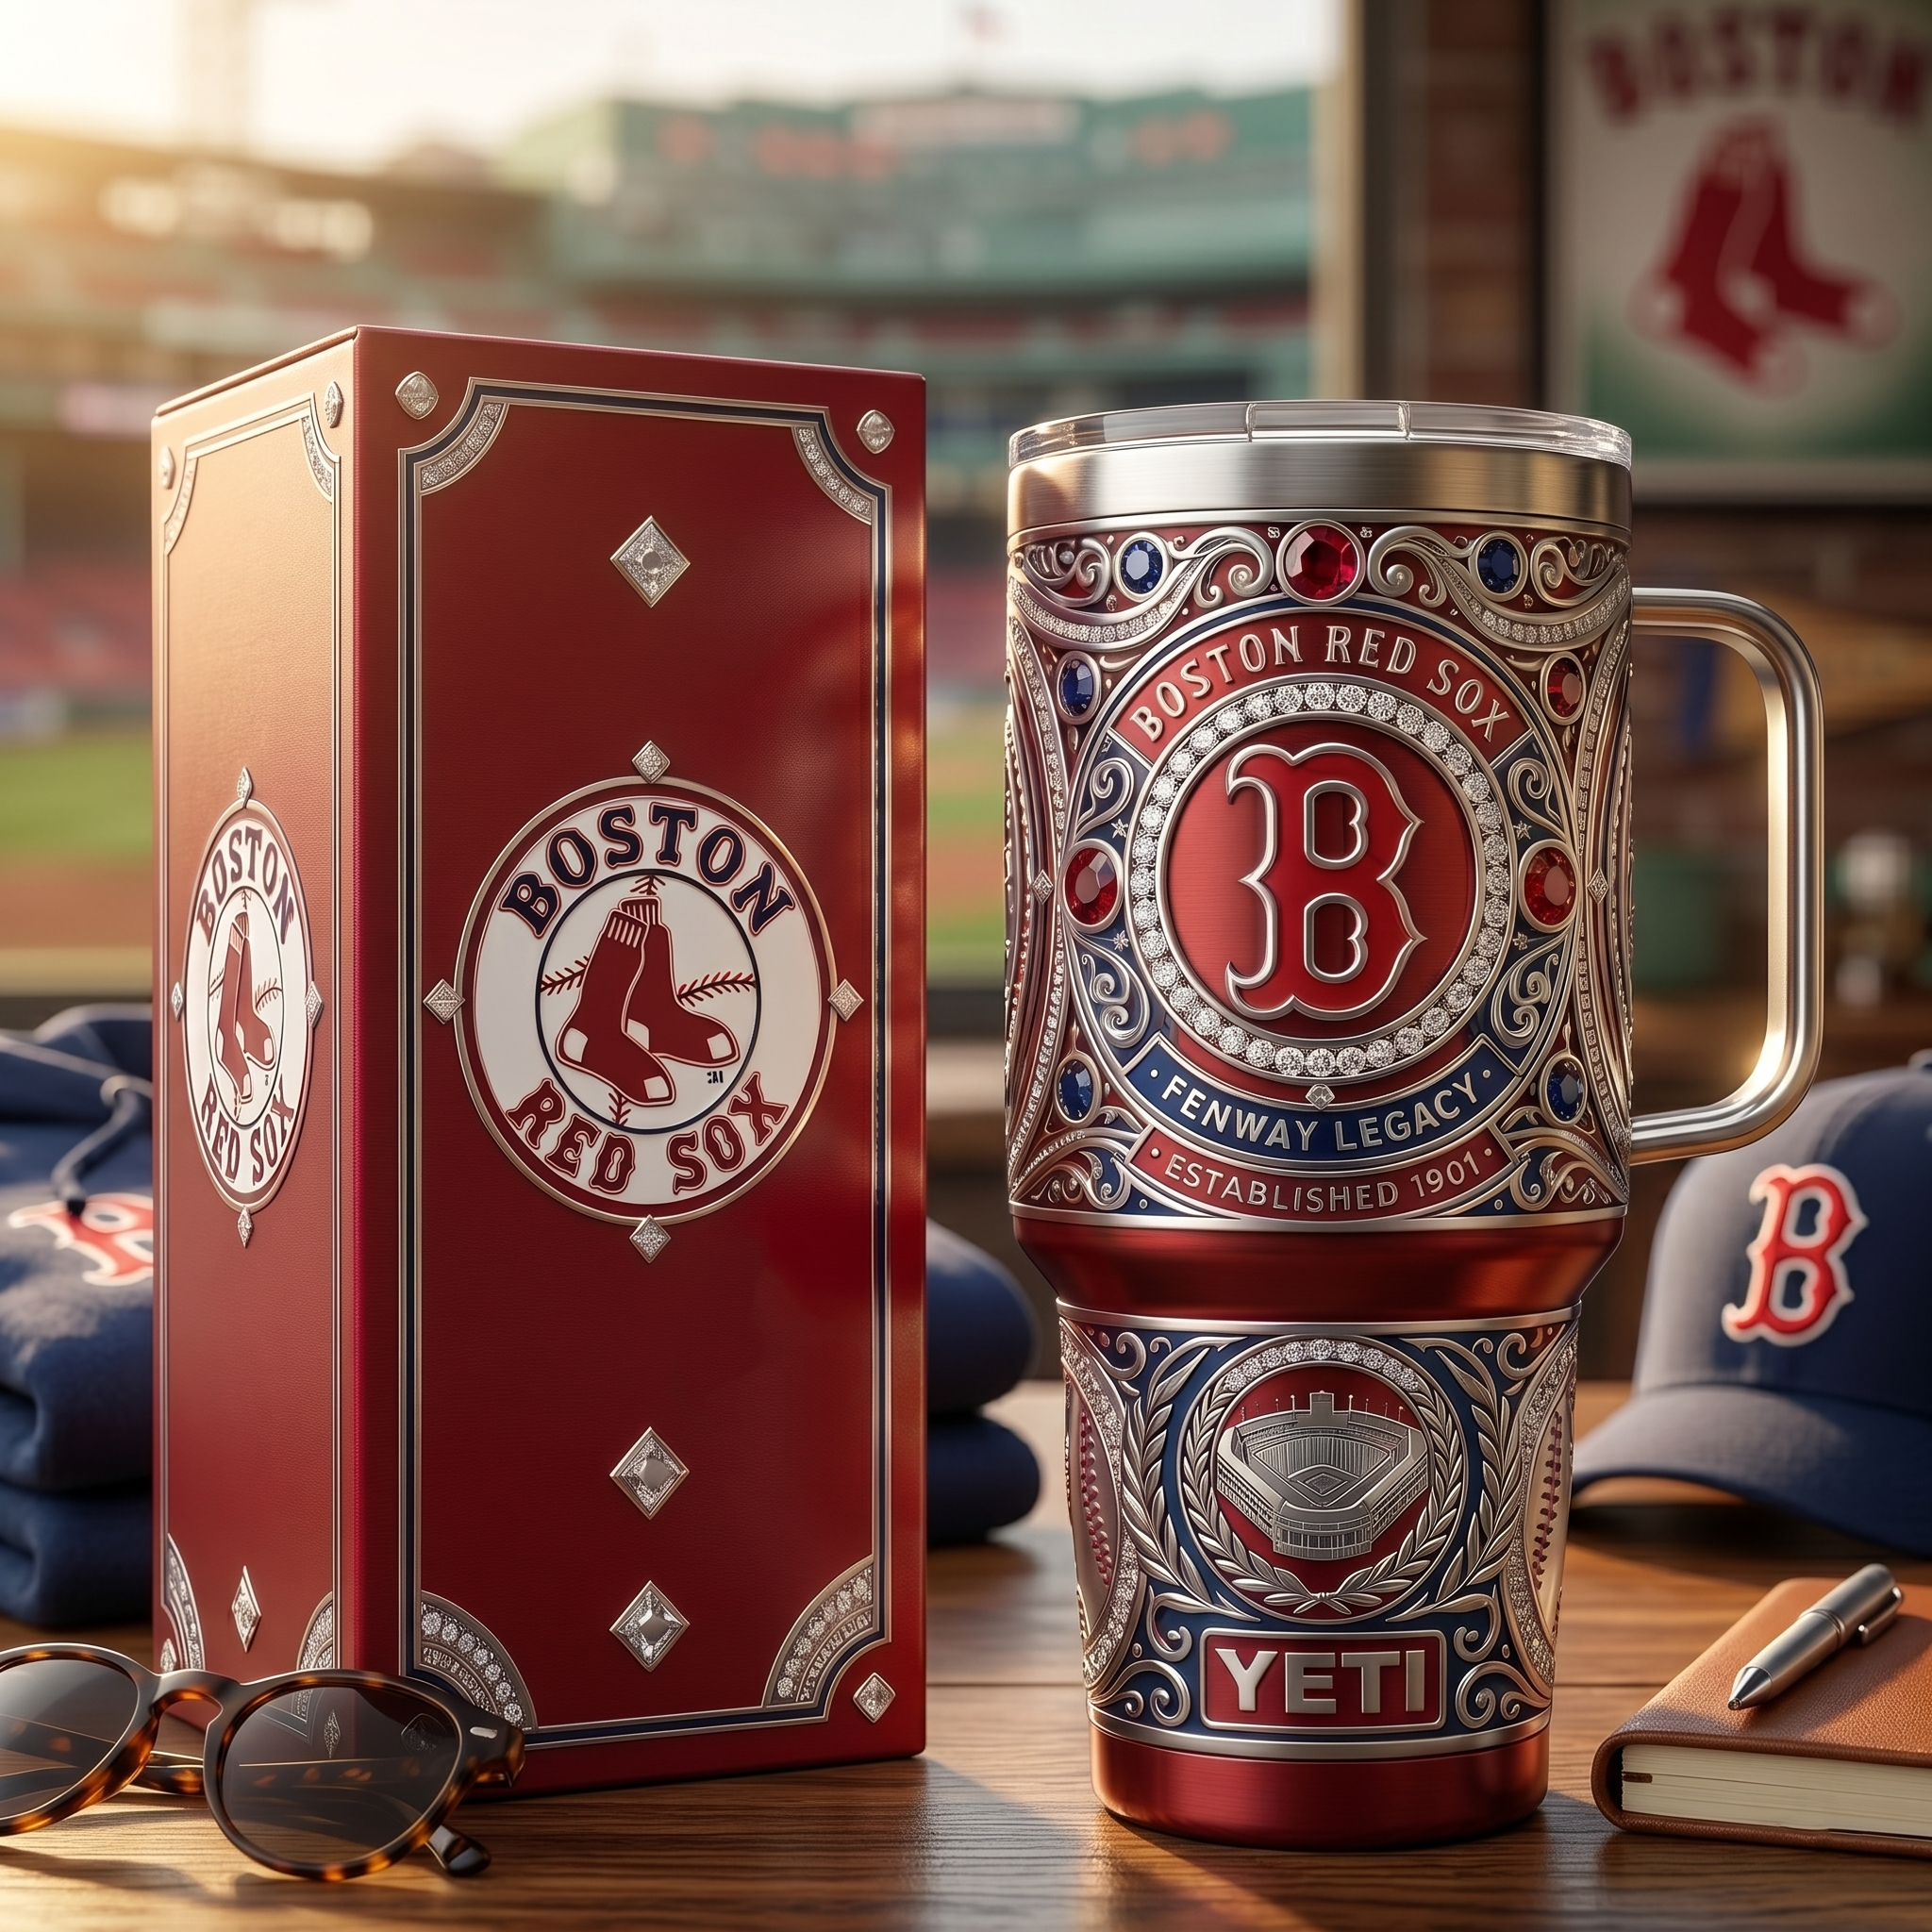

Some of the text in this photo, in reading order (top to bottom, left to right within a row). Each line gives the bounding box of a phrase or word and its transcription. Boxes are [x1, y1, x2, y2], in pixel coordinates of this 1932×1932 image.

[1129, 625, 1509, 741] BOSTON RED SOX
[196, 825, 294, 945] BOSTON
[499, 802, 794, 940] BOSTON
[1225, 742, 1427, 1021] B
[201, 1073, 294, 1187] RED SOX
[506, 1071, 790, 1195] RED SOX
[1161, 1072, 1480, 1152] FENWAY LEGACY
[1163, 1149, 1481, 1213] ESTABLISHED 1901
[1721, 1163, 1870, 1347] B
[1214, 1647, 1425, 1714] YETI
